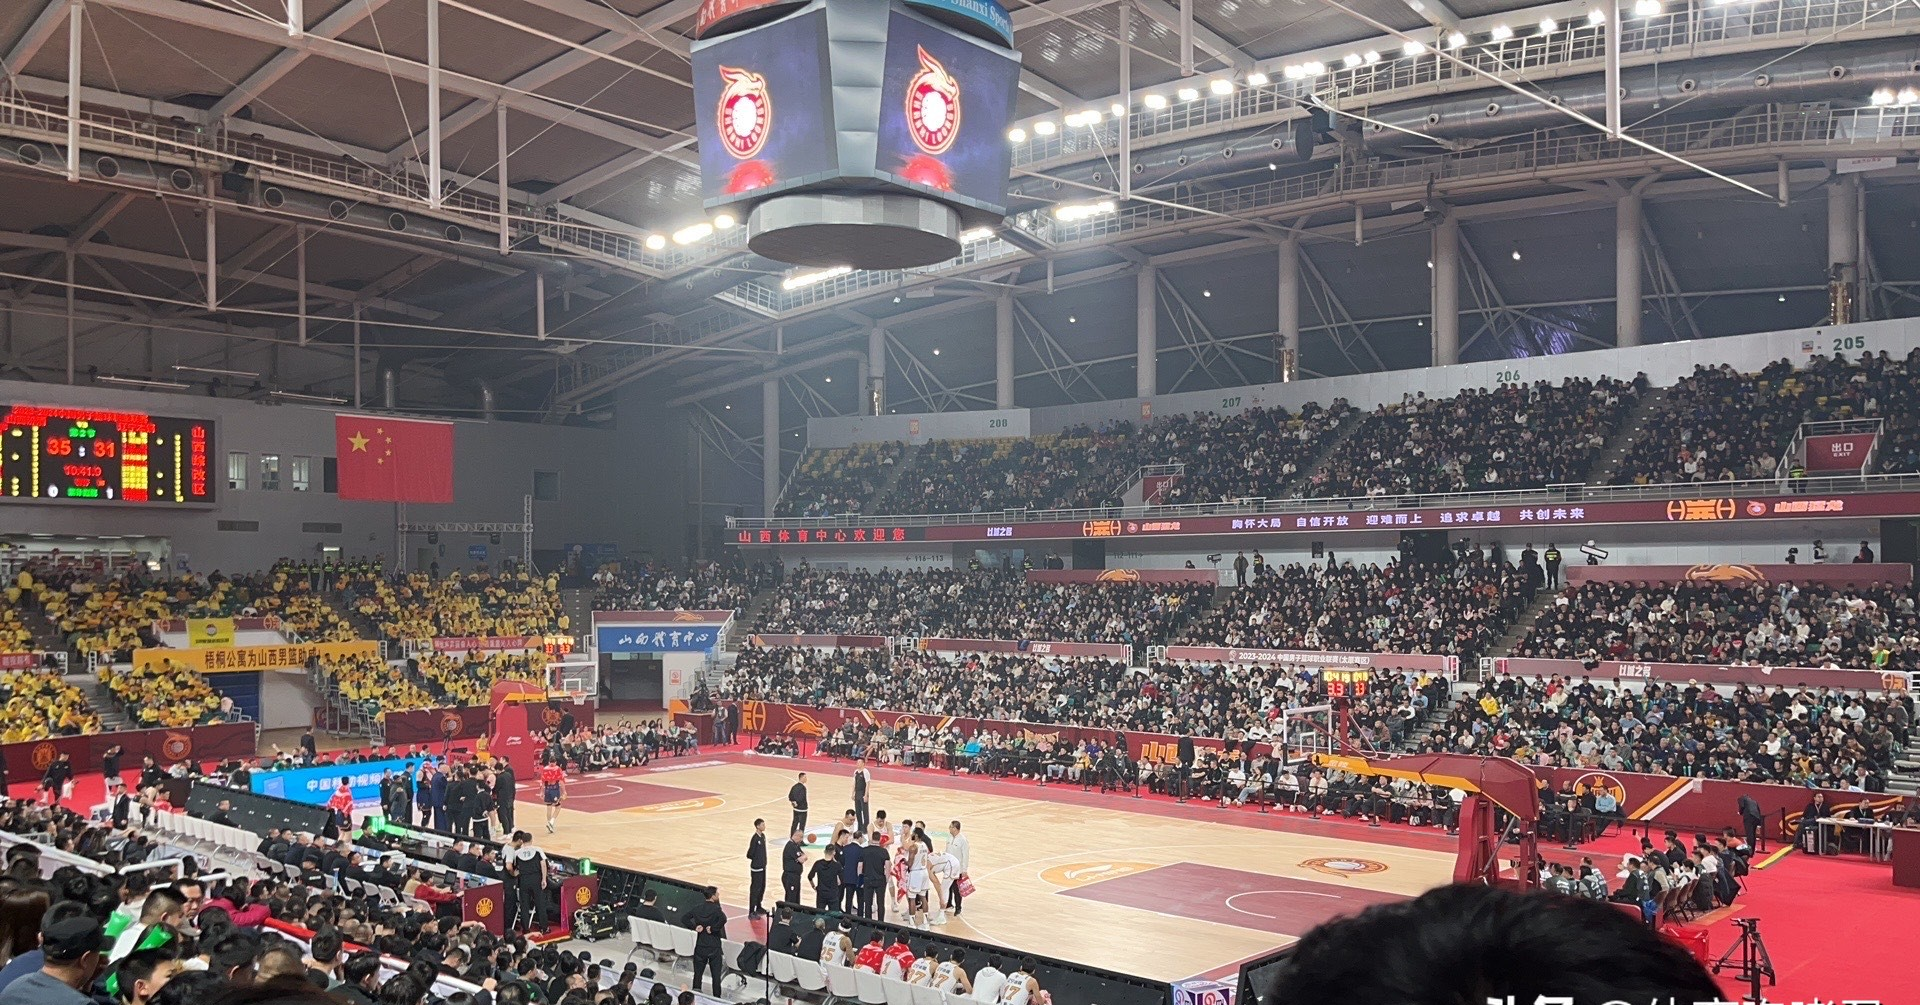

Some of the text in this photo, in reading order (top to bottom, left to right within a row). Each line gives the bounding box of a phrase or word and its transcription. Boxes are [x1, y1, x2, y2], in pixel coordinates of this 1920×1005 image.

[1833, 336, 1865, 351] 205
[1496, 370, 1520, 382] 206
[1222, 397, 1241, 408] 207
[989, 419, 1008, 428] 208
[47, 438, 116, 458] 35 31
[1832, 442, 1854, 452] 出口
[1231, 507, 1586, 530] 胸怀大局 自信开放 迎难而上 追求卓越 共创未来
[738, 527, 906, 543] 山西体育中心欢迎您
[1238, 651, 1277, 661] 2023-2024
